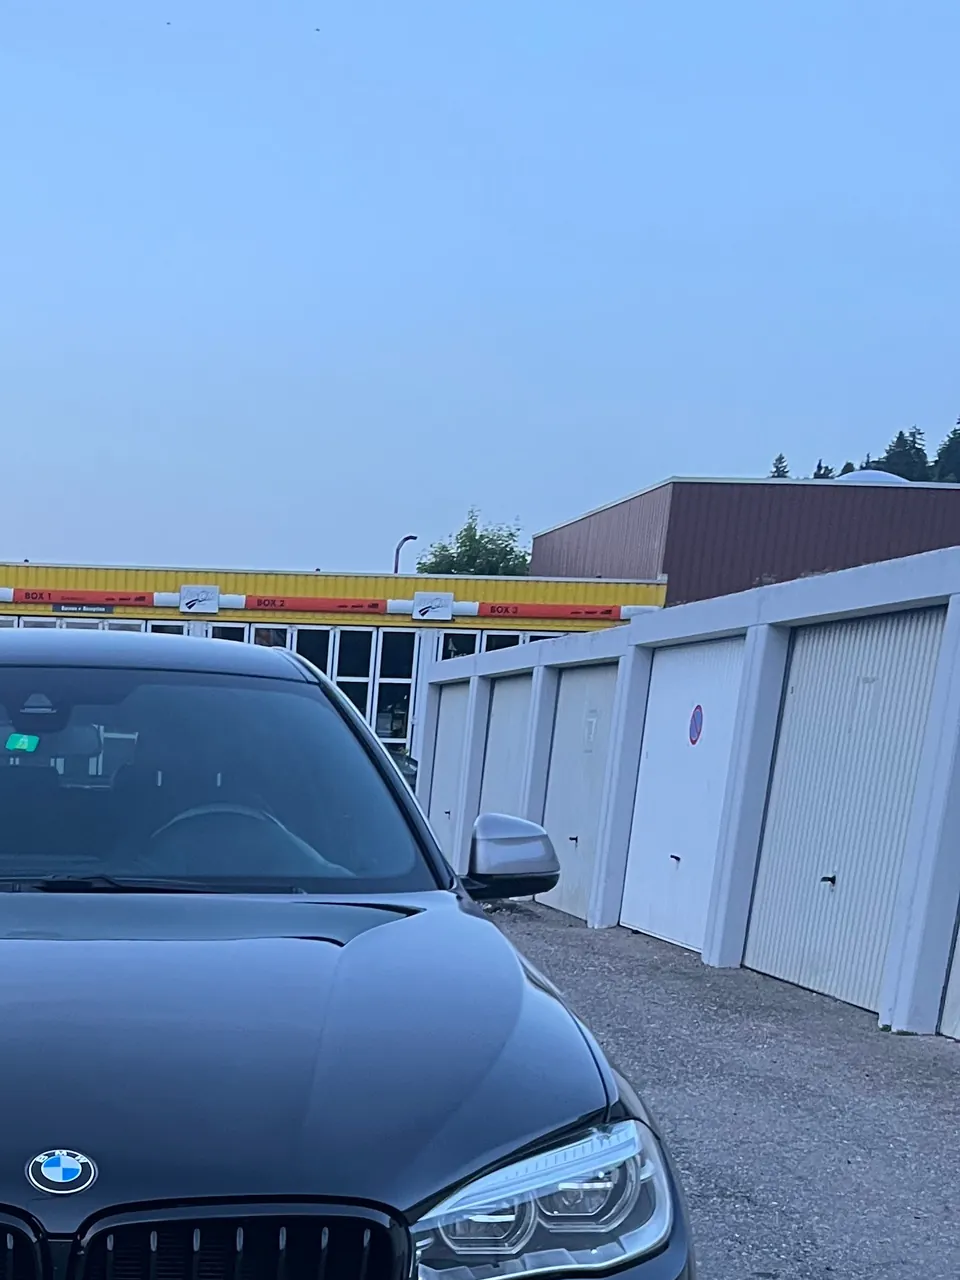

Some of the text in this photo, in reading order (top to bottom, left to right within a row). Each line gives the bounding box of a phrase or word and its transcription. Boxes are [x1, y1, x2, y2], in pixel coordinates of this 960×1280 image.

[24, 592, 44, 600] BOX
[256, 599, 276, 607] BOX
[490, 605, 510, 614] BOX
